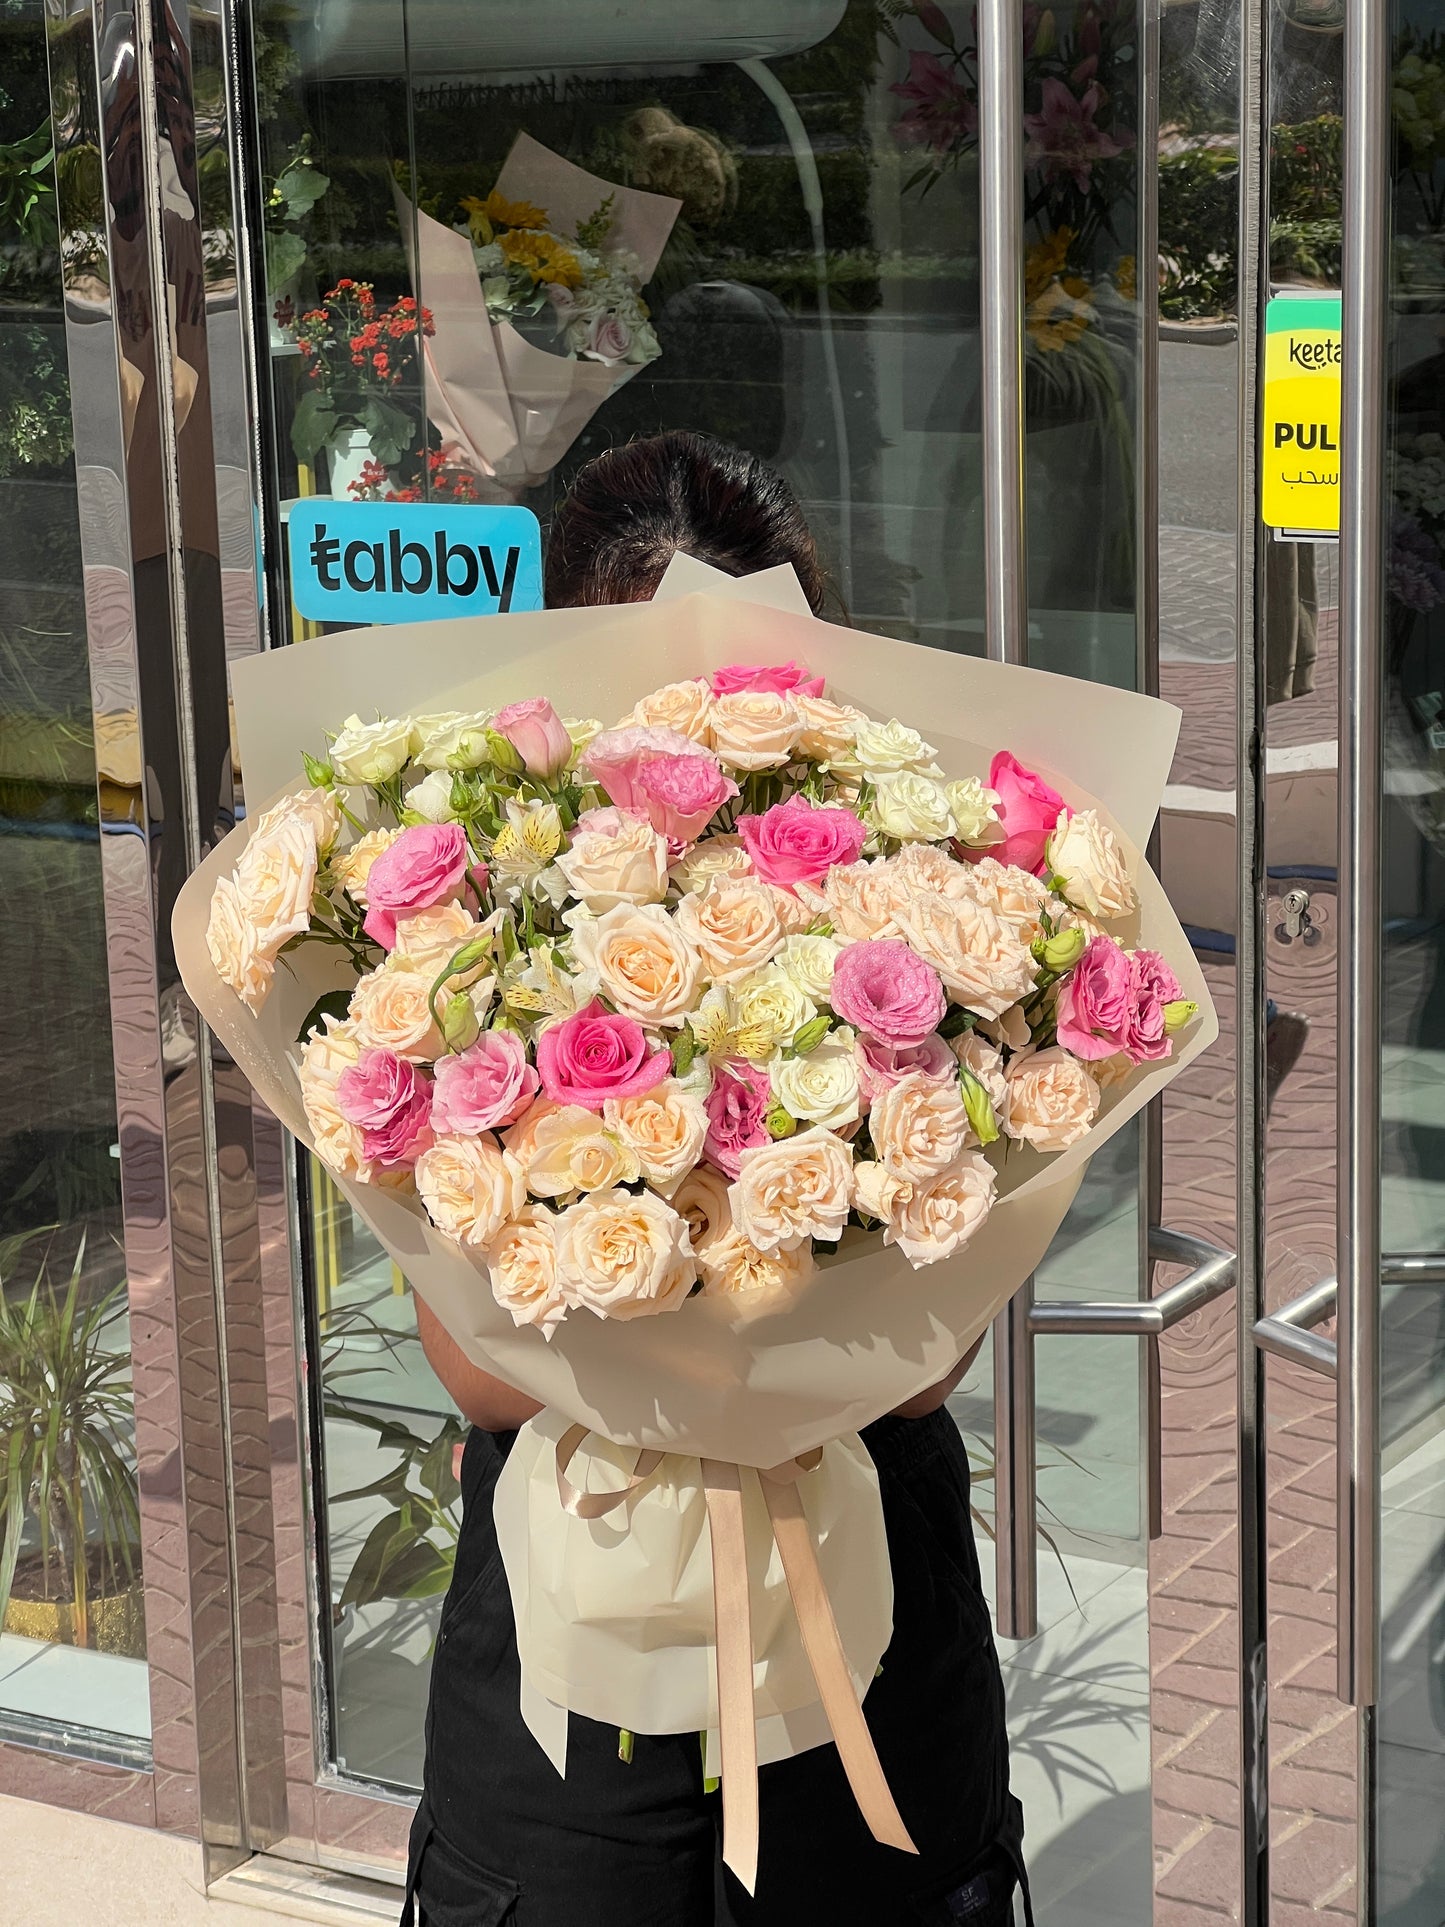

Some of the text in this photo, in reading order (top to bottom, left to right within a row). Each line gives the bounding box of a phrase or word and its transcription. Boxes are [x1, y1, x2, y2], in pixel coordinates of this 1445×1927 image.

[1289, 337, 1342, 370] keeta
[1274, 422, 1339, 451] PUL
[309, 523, 521, 614] tabby
